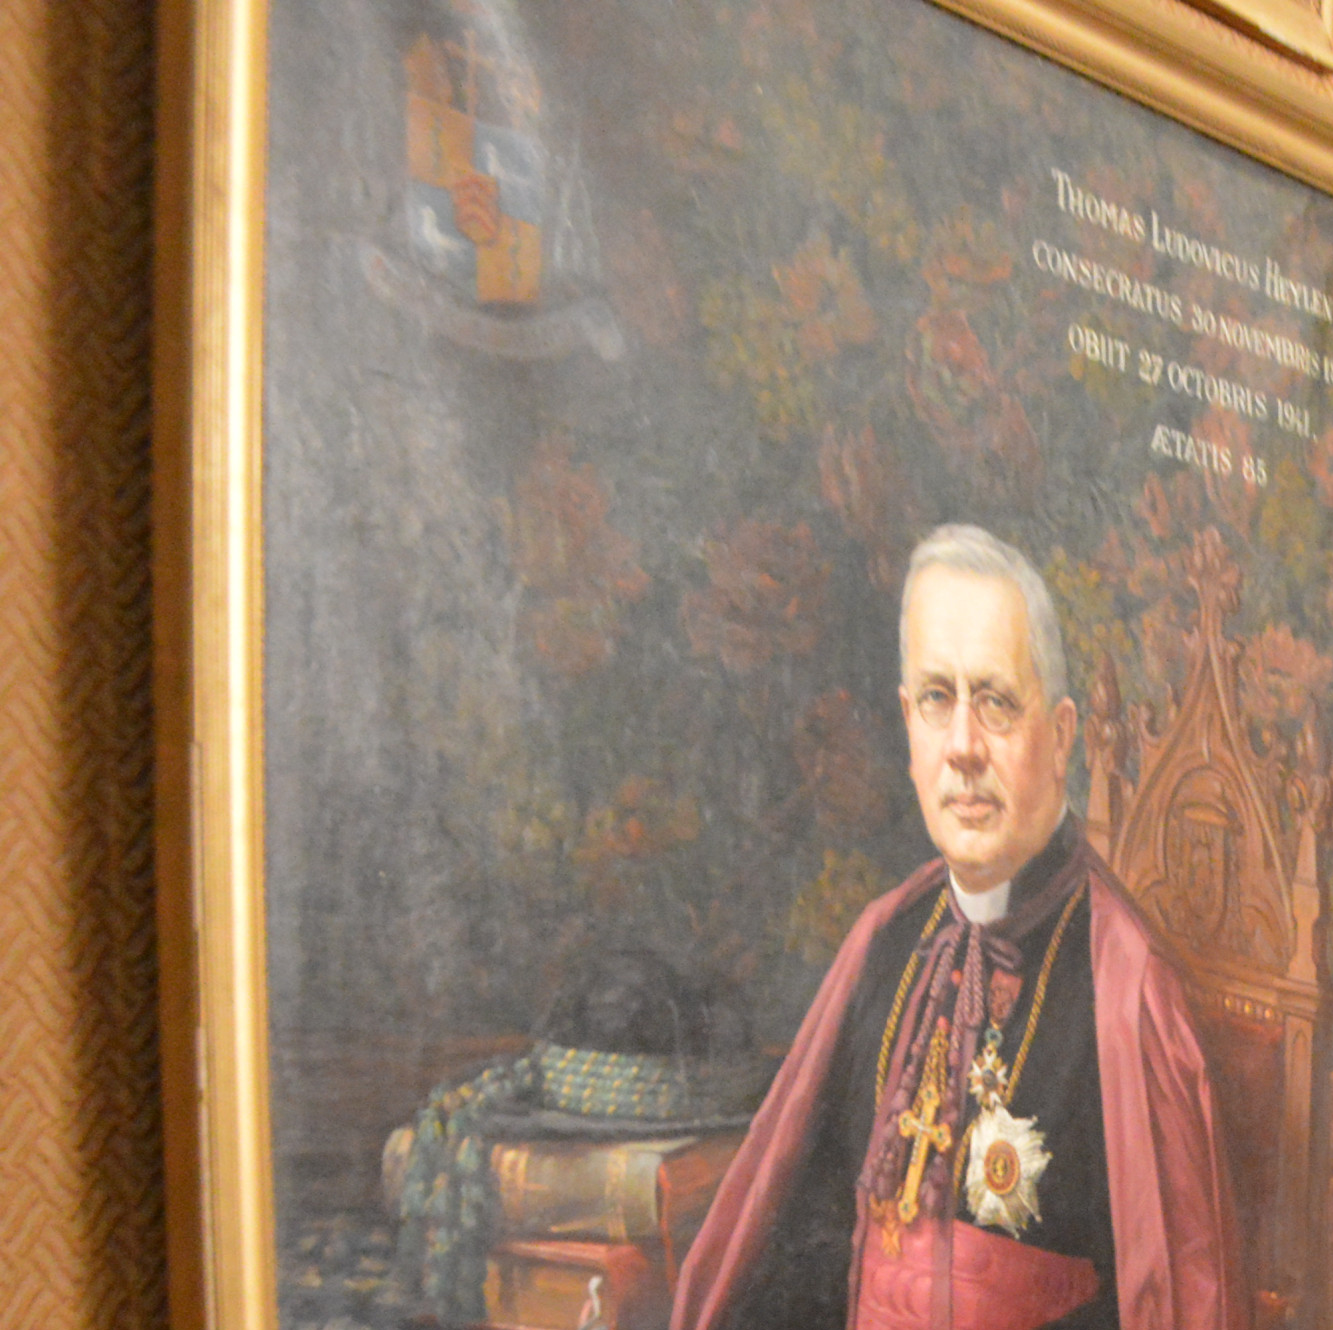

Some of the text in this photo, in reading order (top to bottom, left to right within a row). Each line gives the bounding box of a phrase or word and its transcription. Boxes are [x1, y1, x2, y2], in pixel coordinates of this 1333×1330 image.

[1051, 167, 1146, 242] THOMAS
[1151, 210, 1260, 289] LUDOVICUS
[1032, 239, 1182, 322] CONSECRATUS
[1190, 304, 1216, 335] 30
[1219, 319, 1320, 379] NOVEMBRIS
[1068, 323, 1130, 373] OBIIT
[1137, 349, 1164, 386] 27
[1167, 362, 1268, 419] OCTOBRIS
[1150, 424, 1268, 488] ÆTATIS 85
